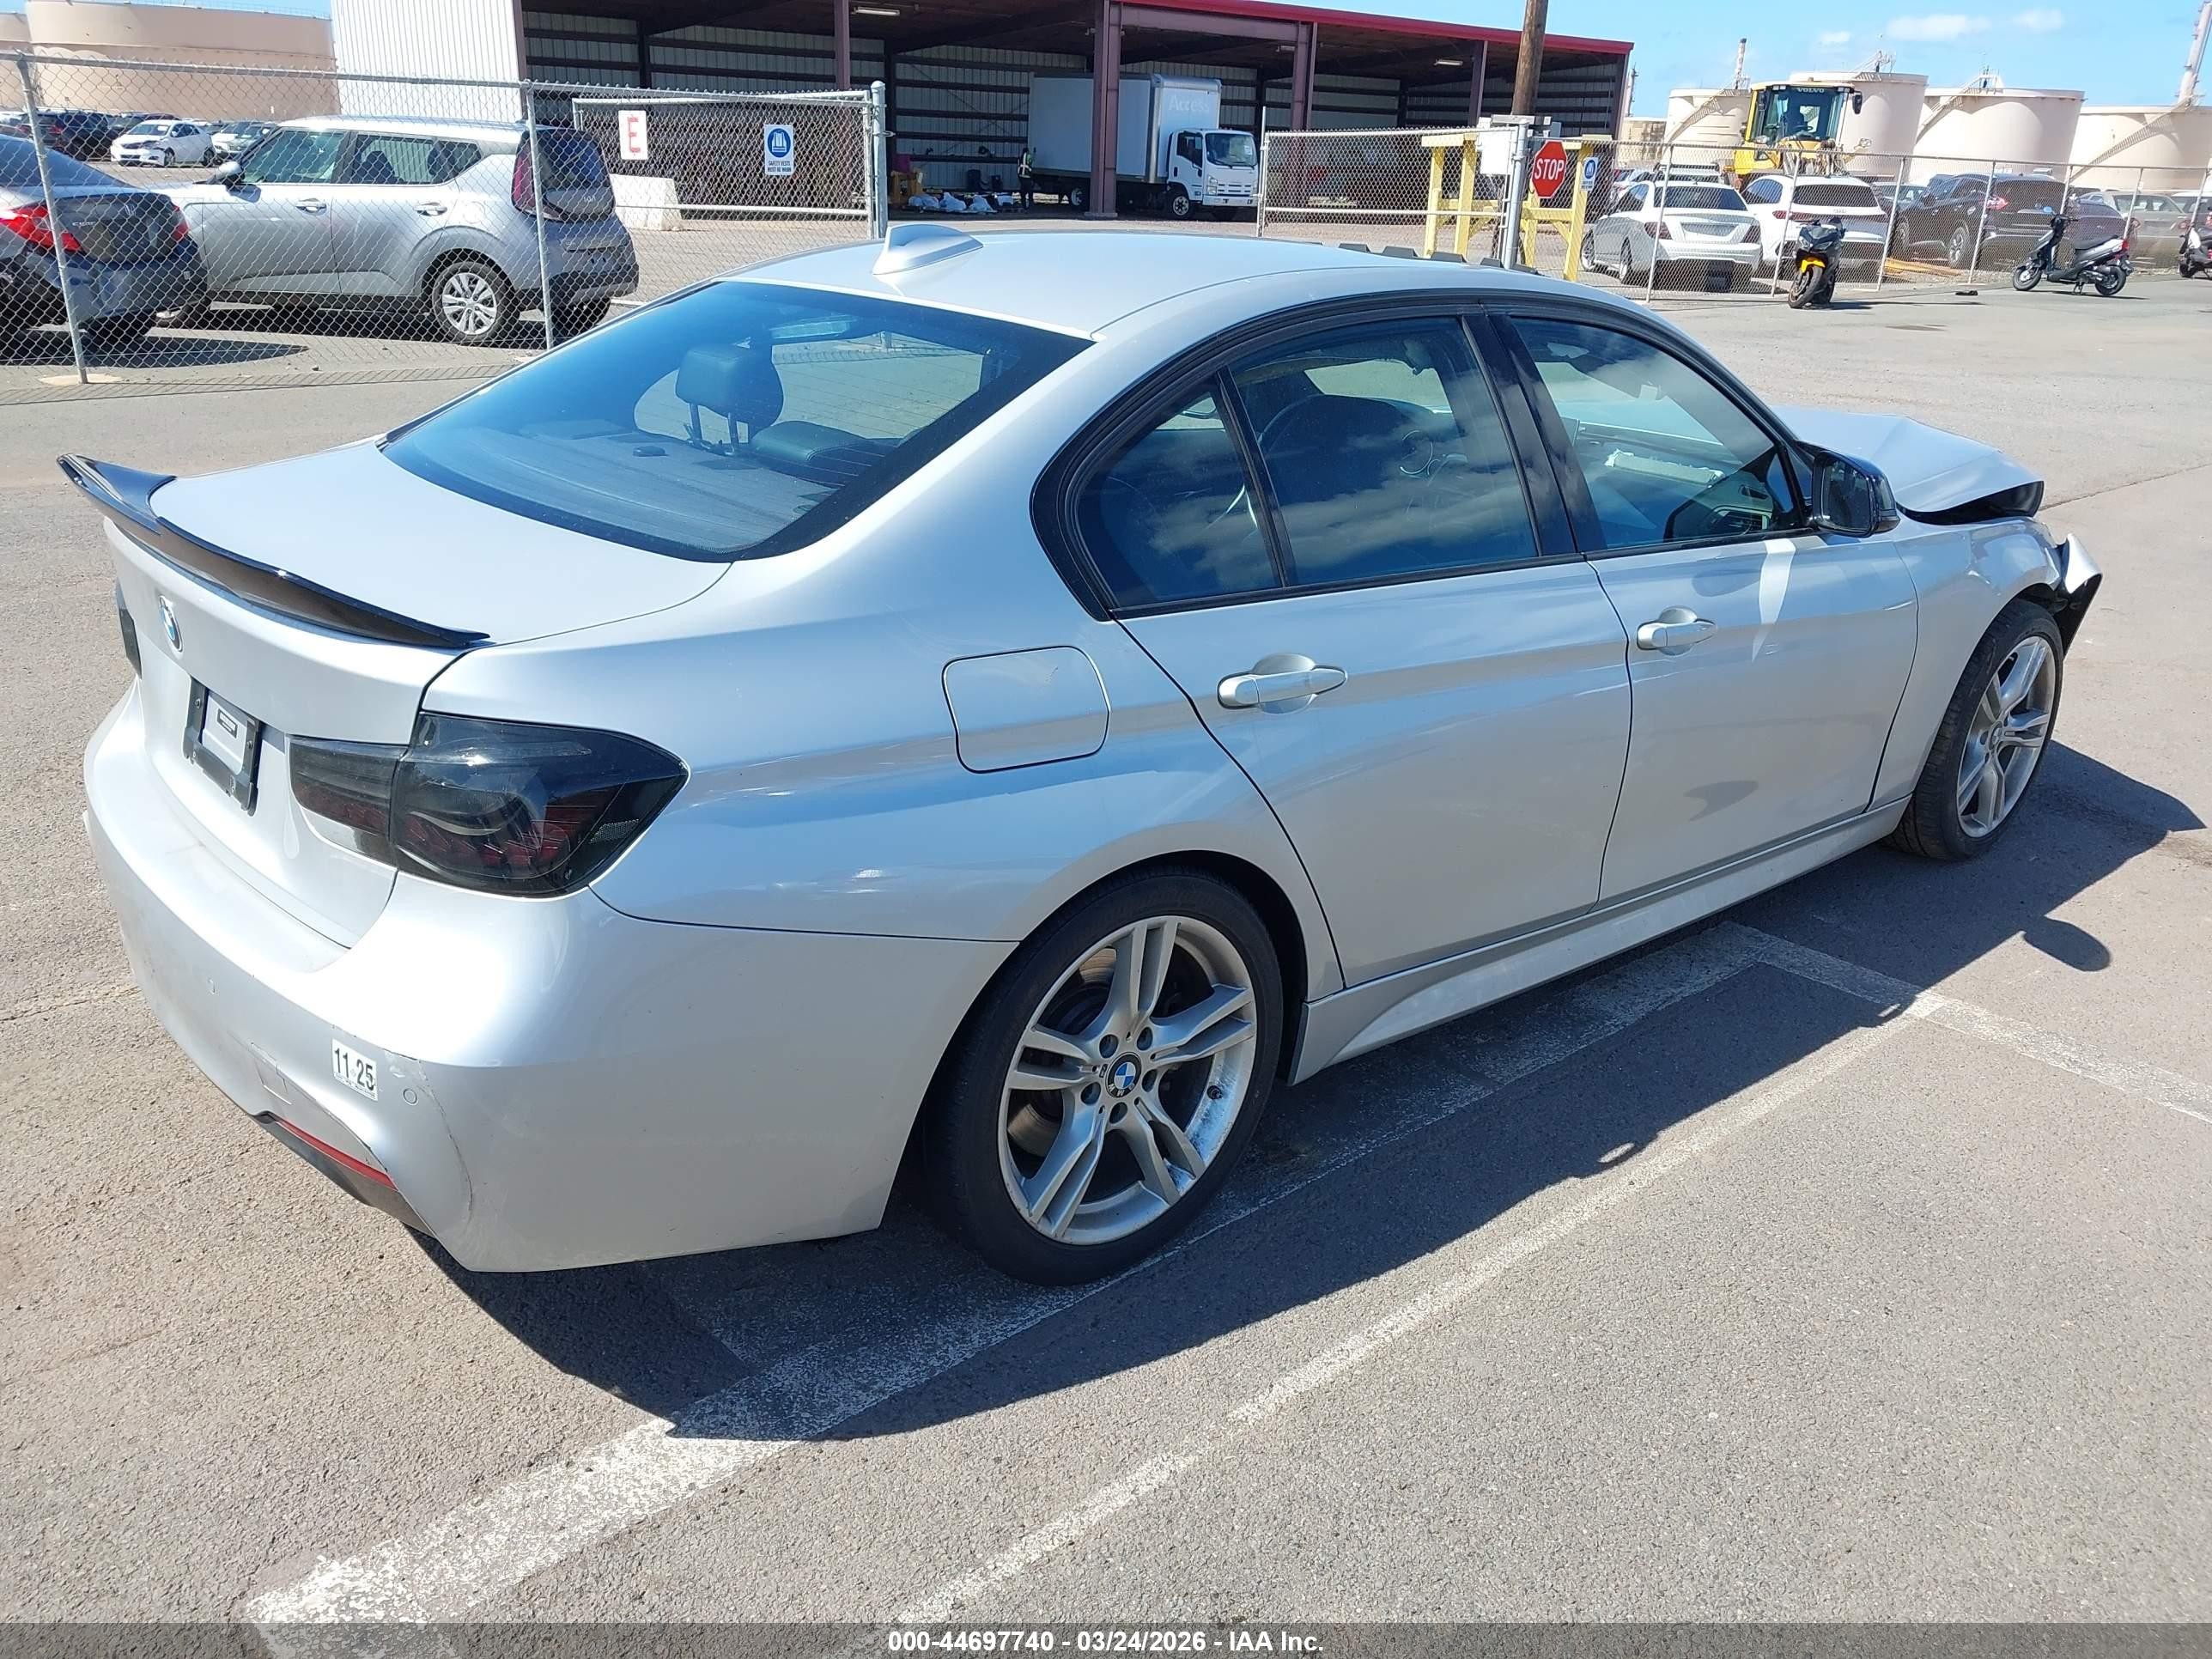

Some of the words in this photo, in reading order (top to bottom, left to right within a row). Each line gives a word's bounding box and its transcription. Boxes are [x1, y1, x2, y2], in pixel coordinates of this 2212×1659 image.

[1168, 95, 1209, 111] Access
[627, 116, 641, 153] E
[1534, 158, 1565, 180] STOP
[335, 1048, 349, 1078] 11
[356, 1059, 374, 1091] 25
